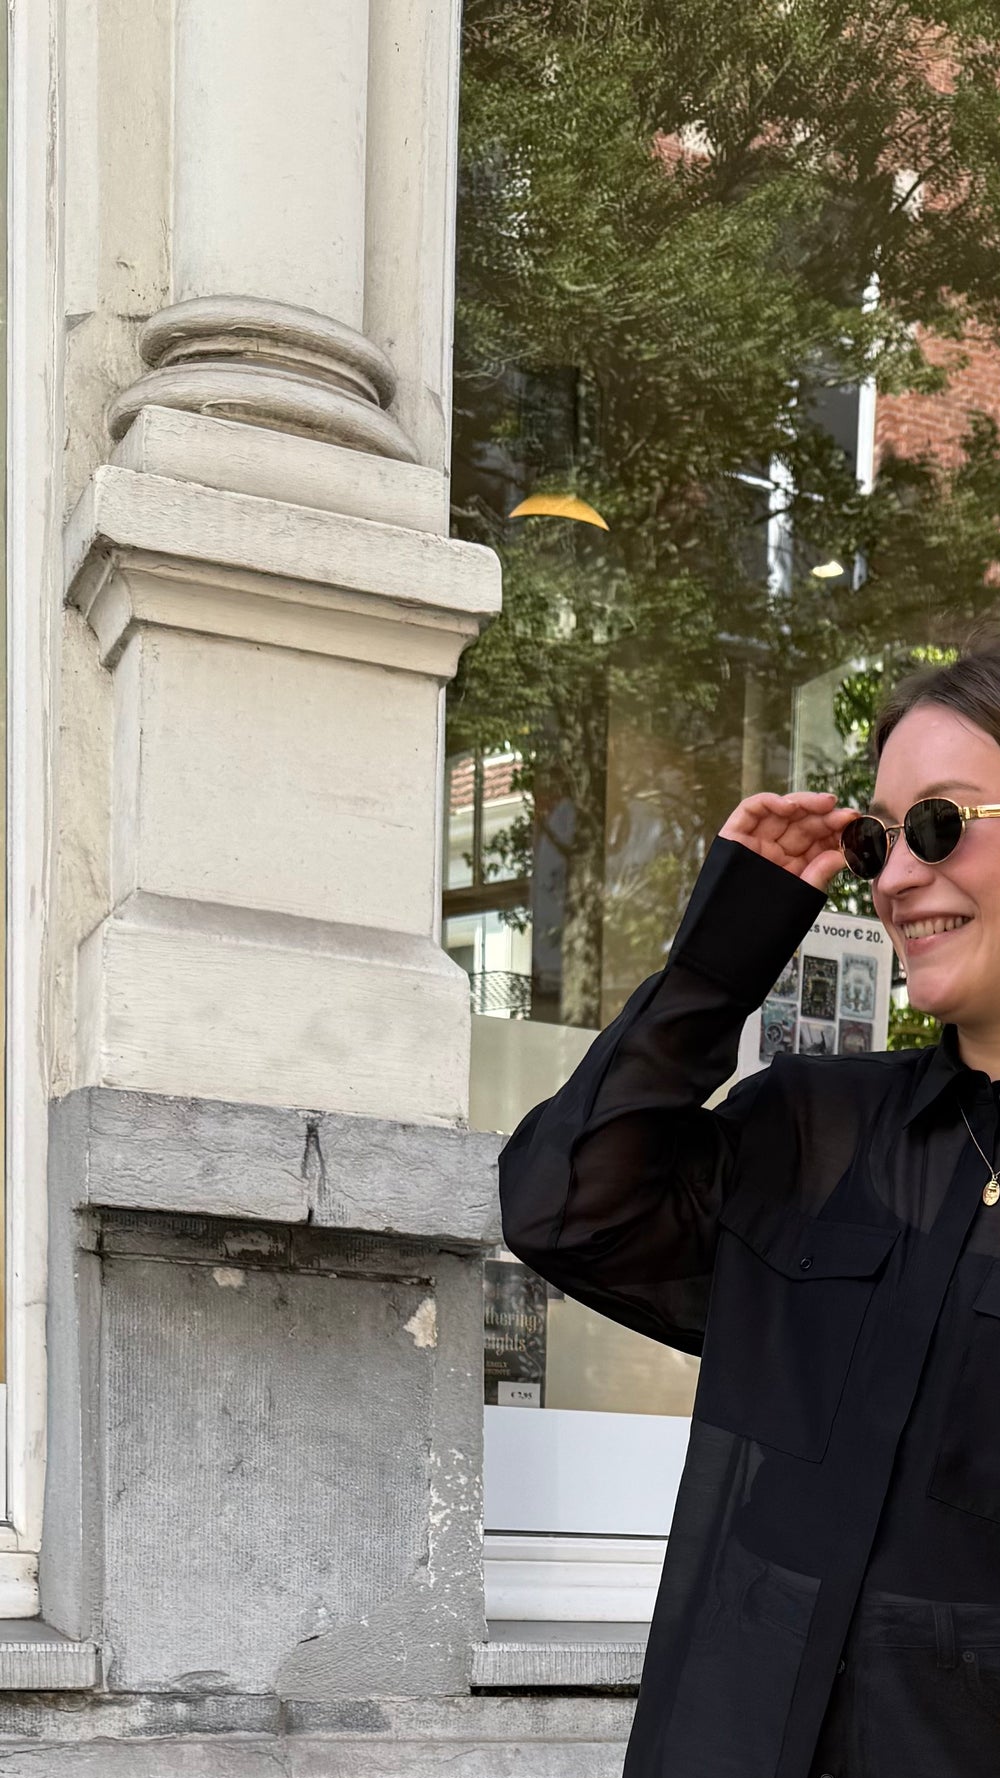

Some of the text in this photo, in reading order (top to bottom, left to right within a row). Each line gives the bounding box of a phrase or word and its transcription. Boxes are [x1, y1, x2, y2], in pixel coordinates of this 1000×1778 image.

[823, 925, 851, 938] voor
[854, 928, 863, 940] €
[866, 930, 884, 944] 20.
